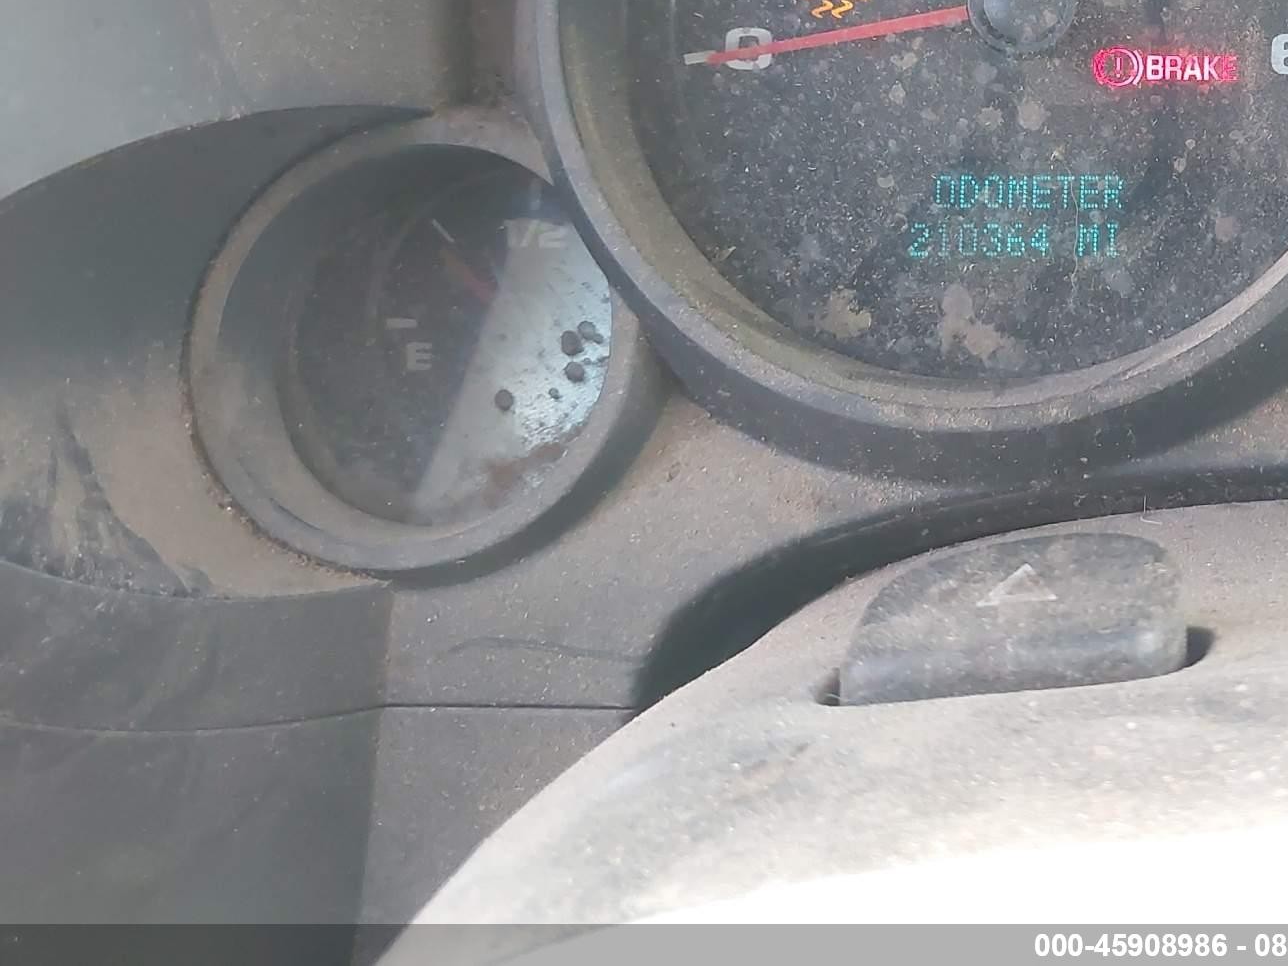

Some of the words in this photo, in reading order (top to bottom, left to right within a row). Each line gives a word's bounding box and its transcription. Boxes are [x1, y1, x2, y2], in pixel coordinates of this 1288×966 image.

[725, 27, 773, 71] 0
[1146, 55, 1238, 81] BRAKE
[934, 172, 1124, 209] ODOMETER
[910, 222, 1050, 258] 210364
[1077, 222, 1120, 258] MI
[407, 341, 432, 371] E
